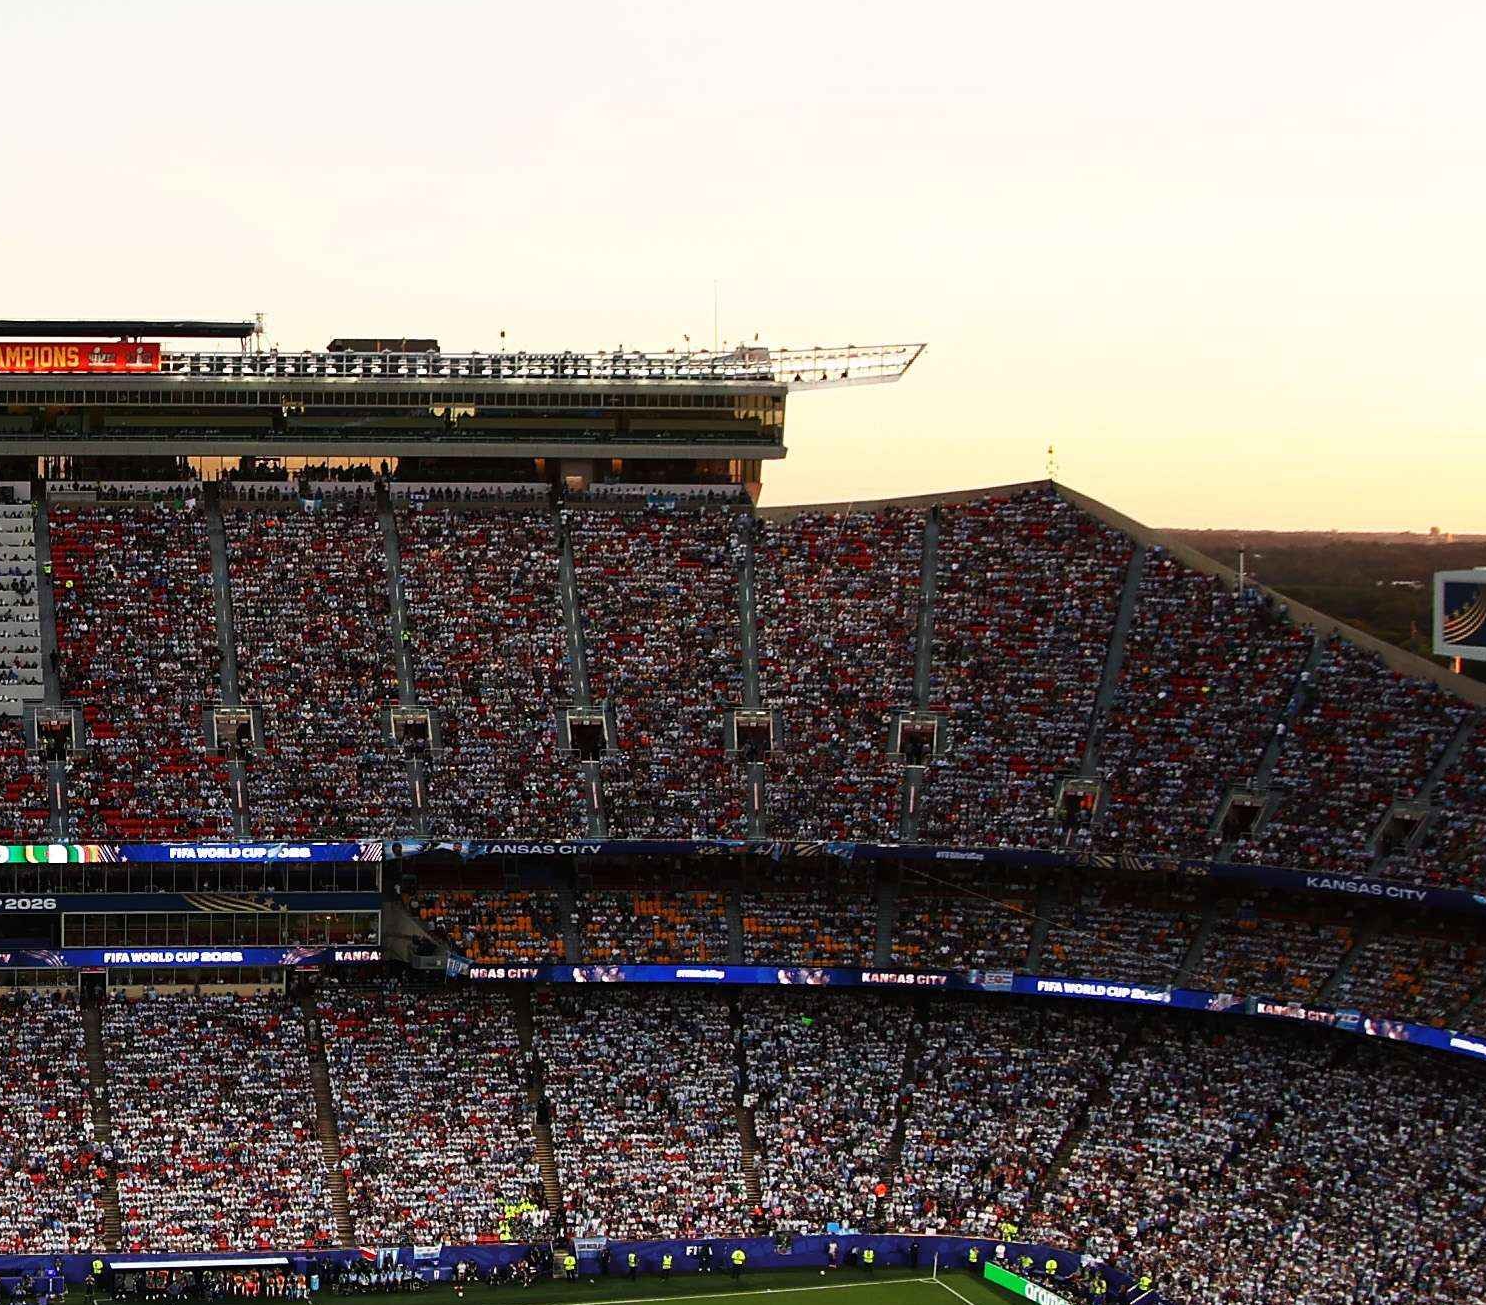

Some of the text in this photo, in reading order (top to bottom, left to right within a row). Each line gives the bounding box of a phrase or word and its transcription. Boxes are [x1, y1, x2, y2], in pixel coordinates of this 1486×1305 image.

[170, 848, 195, 858] FIFA
[196, 848, 241, 858] WORLD
[486, 845, 555, 854] ANSAS
[1307, 877, 1427, 901] KANSAS CITY
[5, 898, 57, 910] 2026
[104, 953, 129, 963] FIFA
[131, 952, 174, 963] WORLD
[175, 952, 200, 963] CUP
[508, 969, 538, 978] CITY
[862, 973, 947, 985] KANSAS CITY
[1038, 981, 1063, 992] FIFA
[1064, 982, 1105, 995] WORLD
